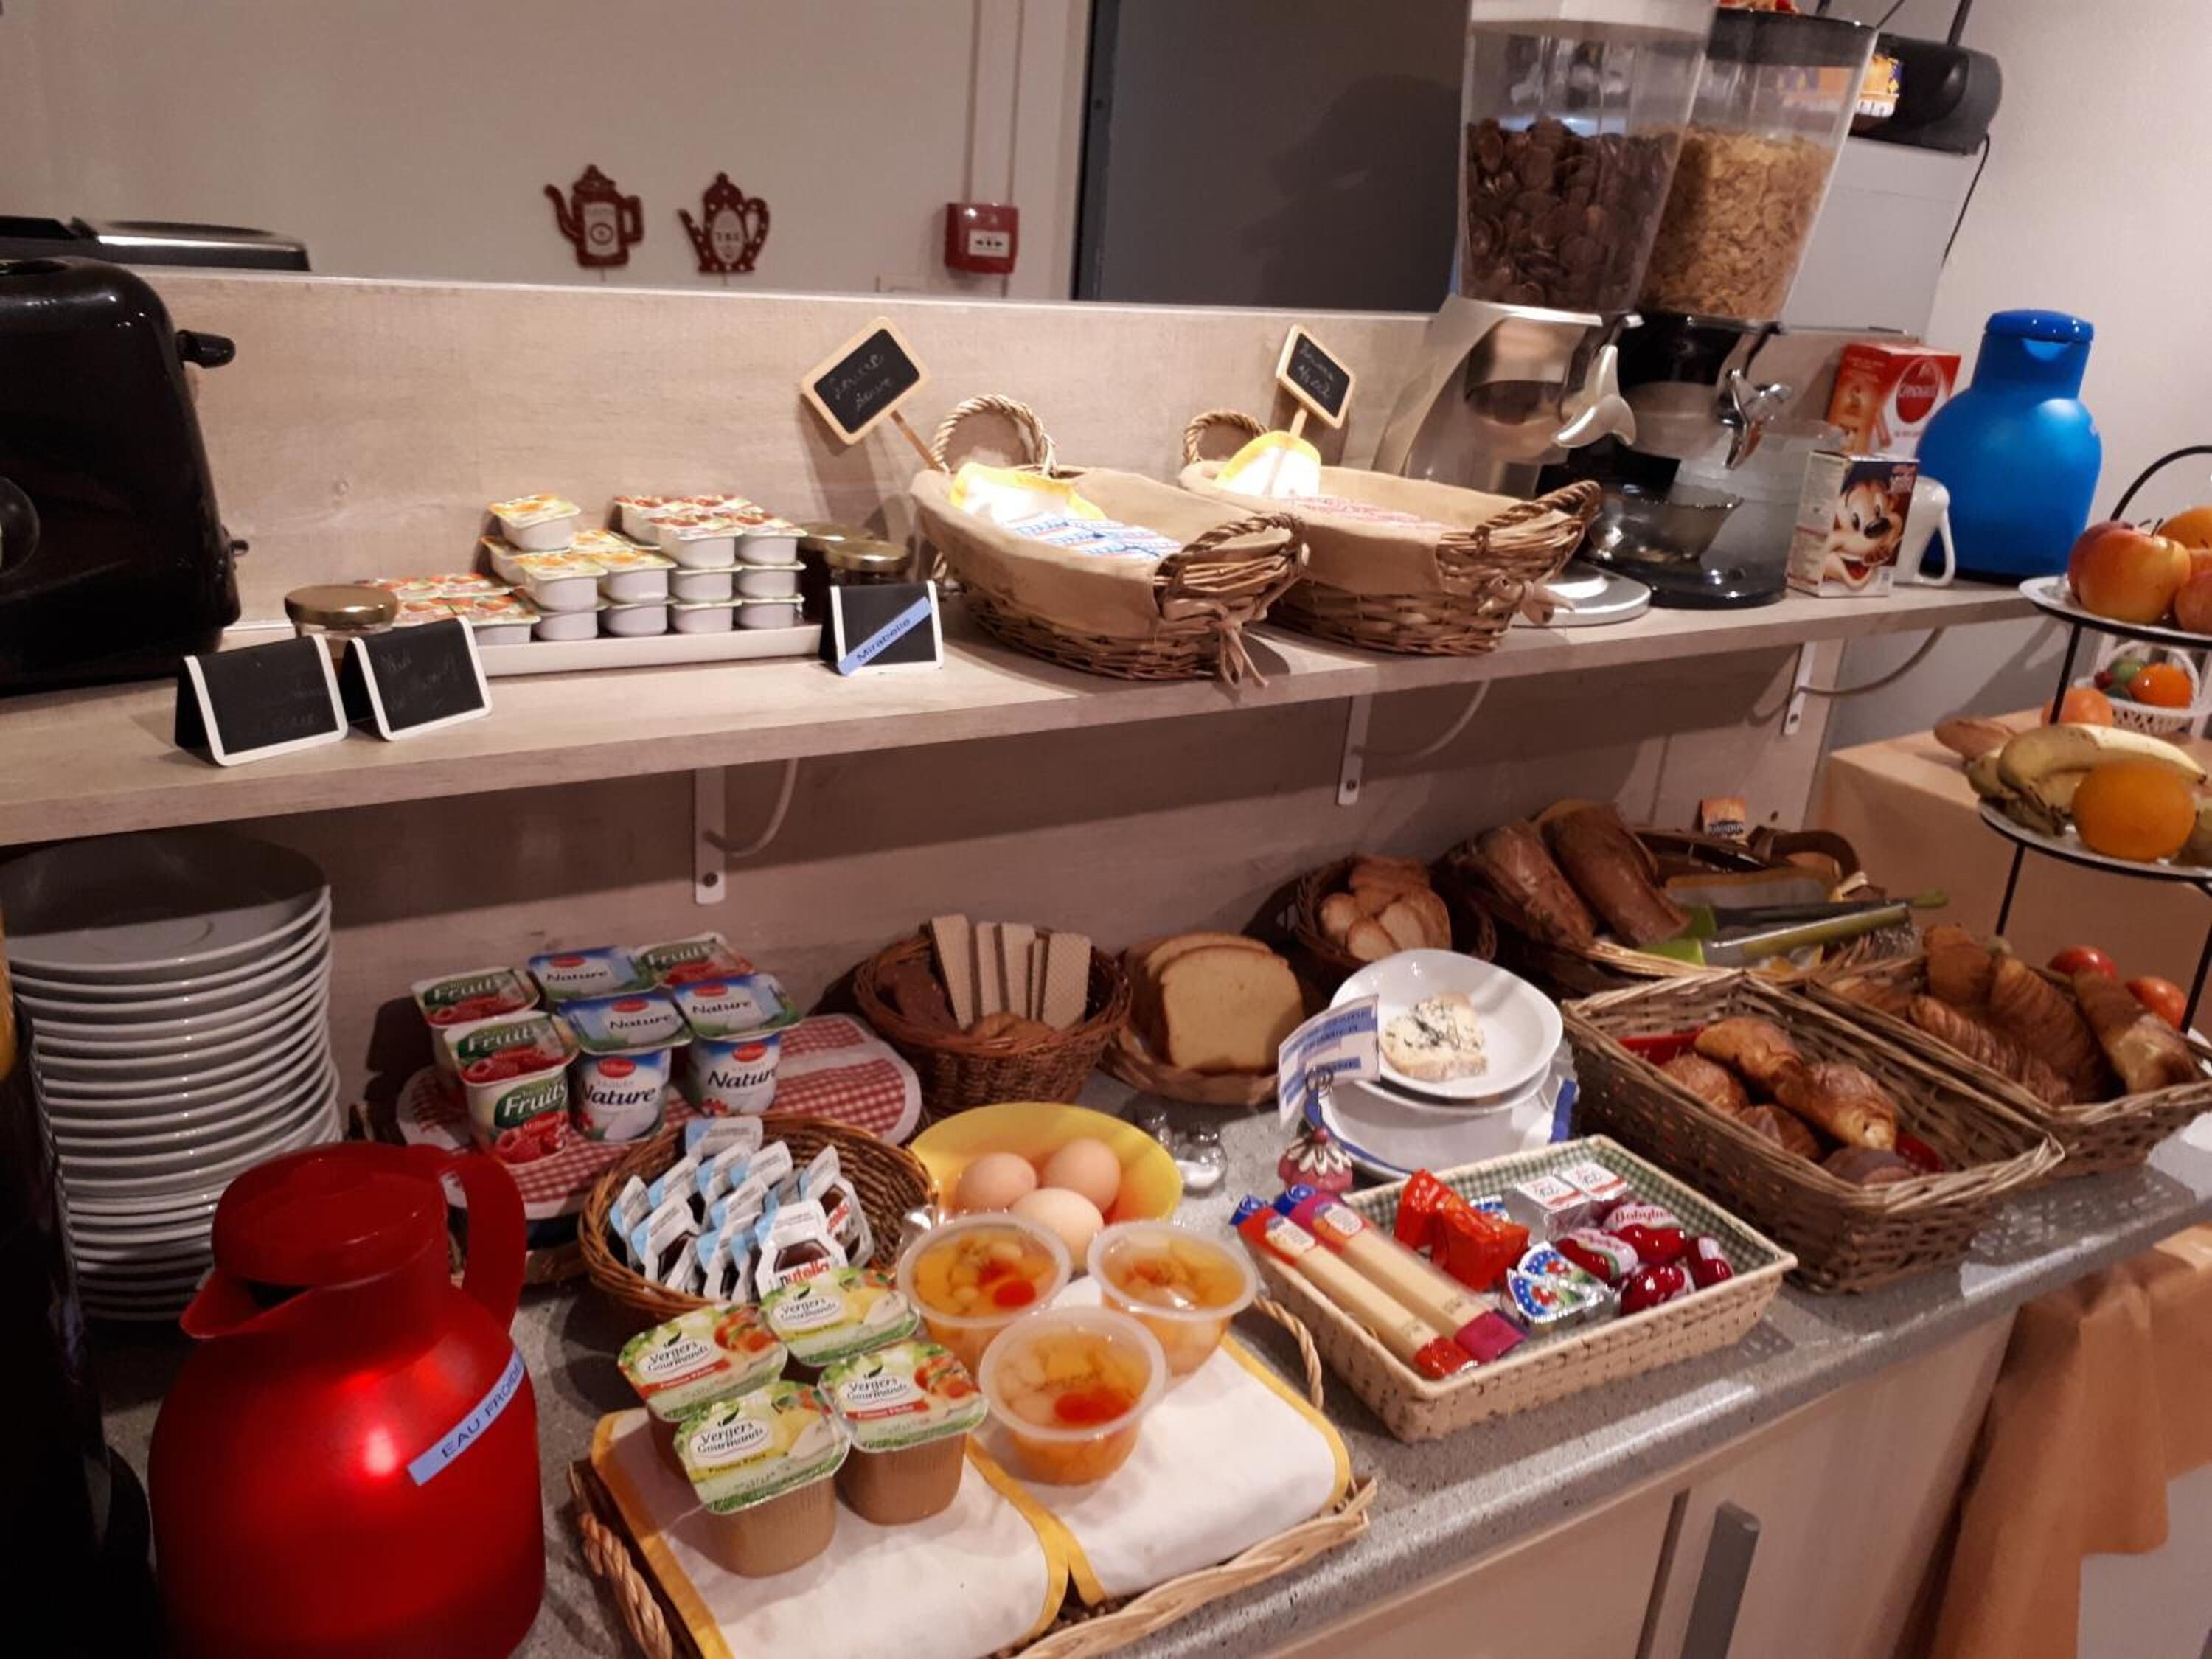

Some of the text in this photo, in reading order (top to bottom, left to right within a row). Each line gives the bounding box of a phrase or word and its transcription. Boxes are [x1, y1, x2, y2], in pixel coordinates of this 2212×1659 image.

[856, 619, 911, 661] Mirabelle
[546, 968, 608, 981] Nature
[692, 1000, 752, 1015] Nature
[610, 1014, 672, 1030] Nature
[580, 1082, 656, 1106] Nature
[779, 1257, 830, 1287] nutella
[782, 1298, 827, 1315] Vergers
[650, 1340, 699, 1364] Vergers
[849, 1377, 898, 1394] Vergers
[442, 1418, 481, 1458] EAU
[701, 1422, 754, 1444] Vergers
